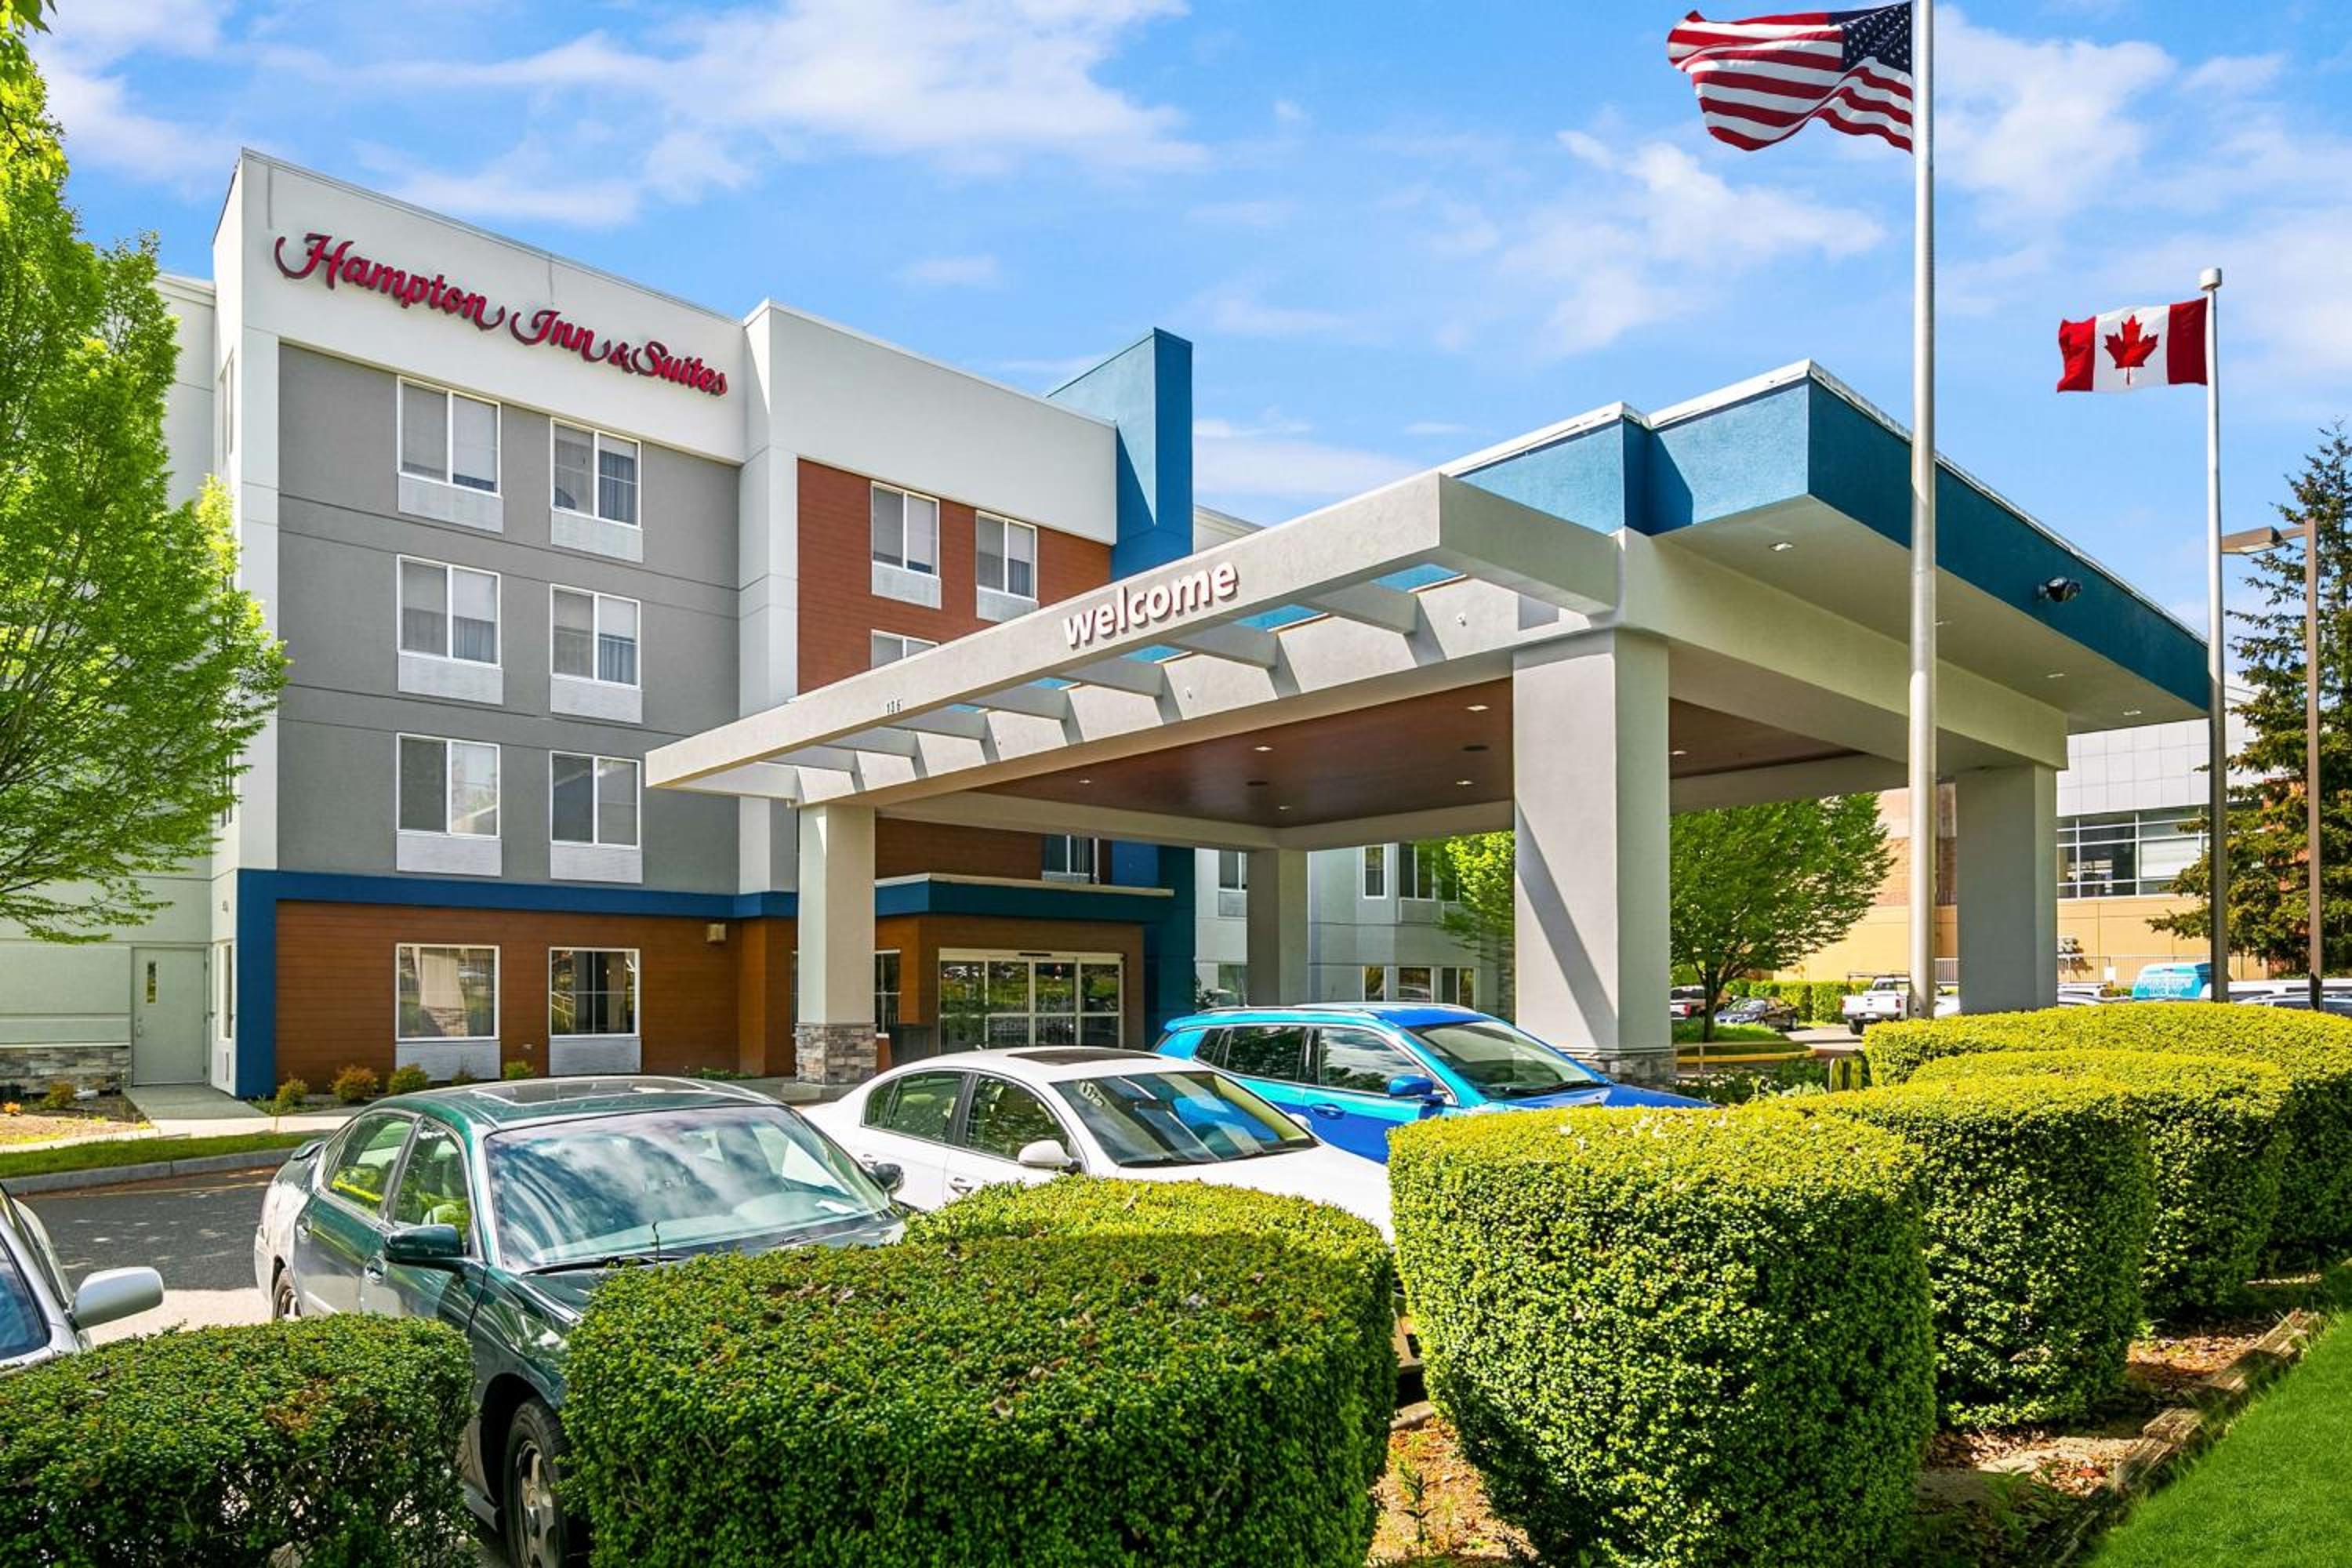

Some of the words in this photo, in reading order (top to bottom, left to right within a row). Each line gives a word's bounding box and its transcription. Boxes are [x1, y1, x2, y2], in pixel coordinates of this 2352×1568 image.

[274, 233, 505, 331] Hampton
[510, 310, 611, 362] Inn
[608, 342, 634, 373] &
[631, 341, 728, 395] Suites
[1062, 562, 1239, 648] welcome
